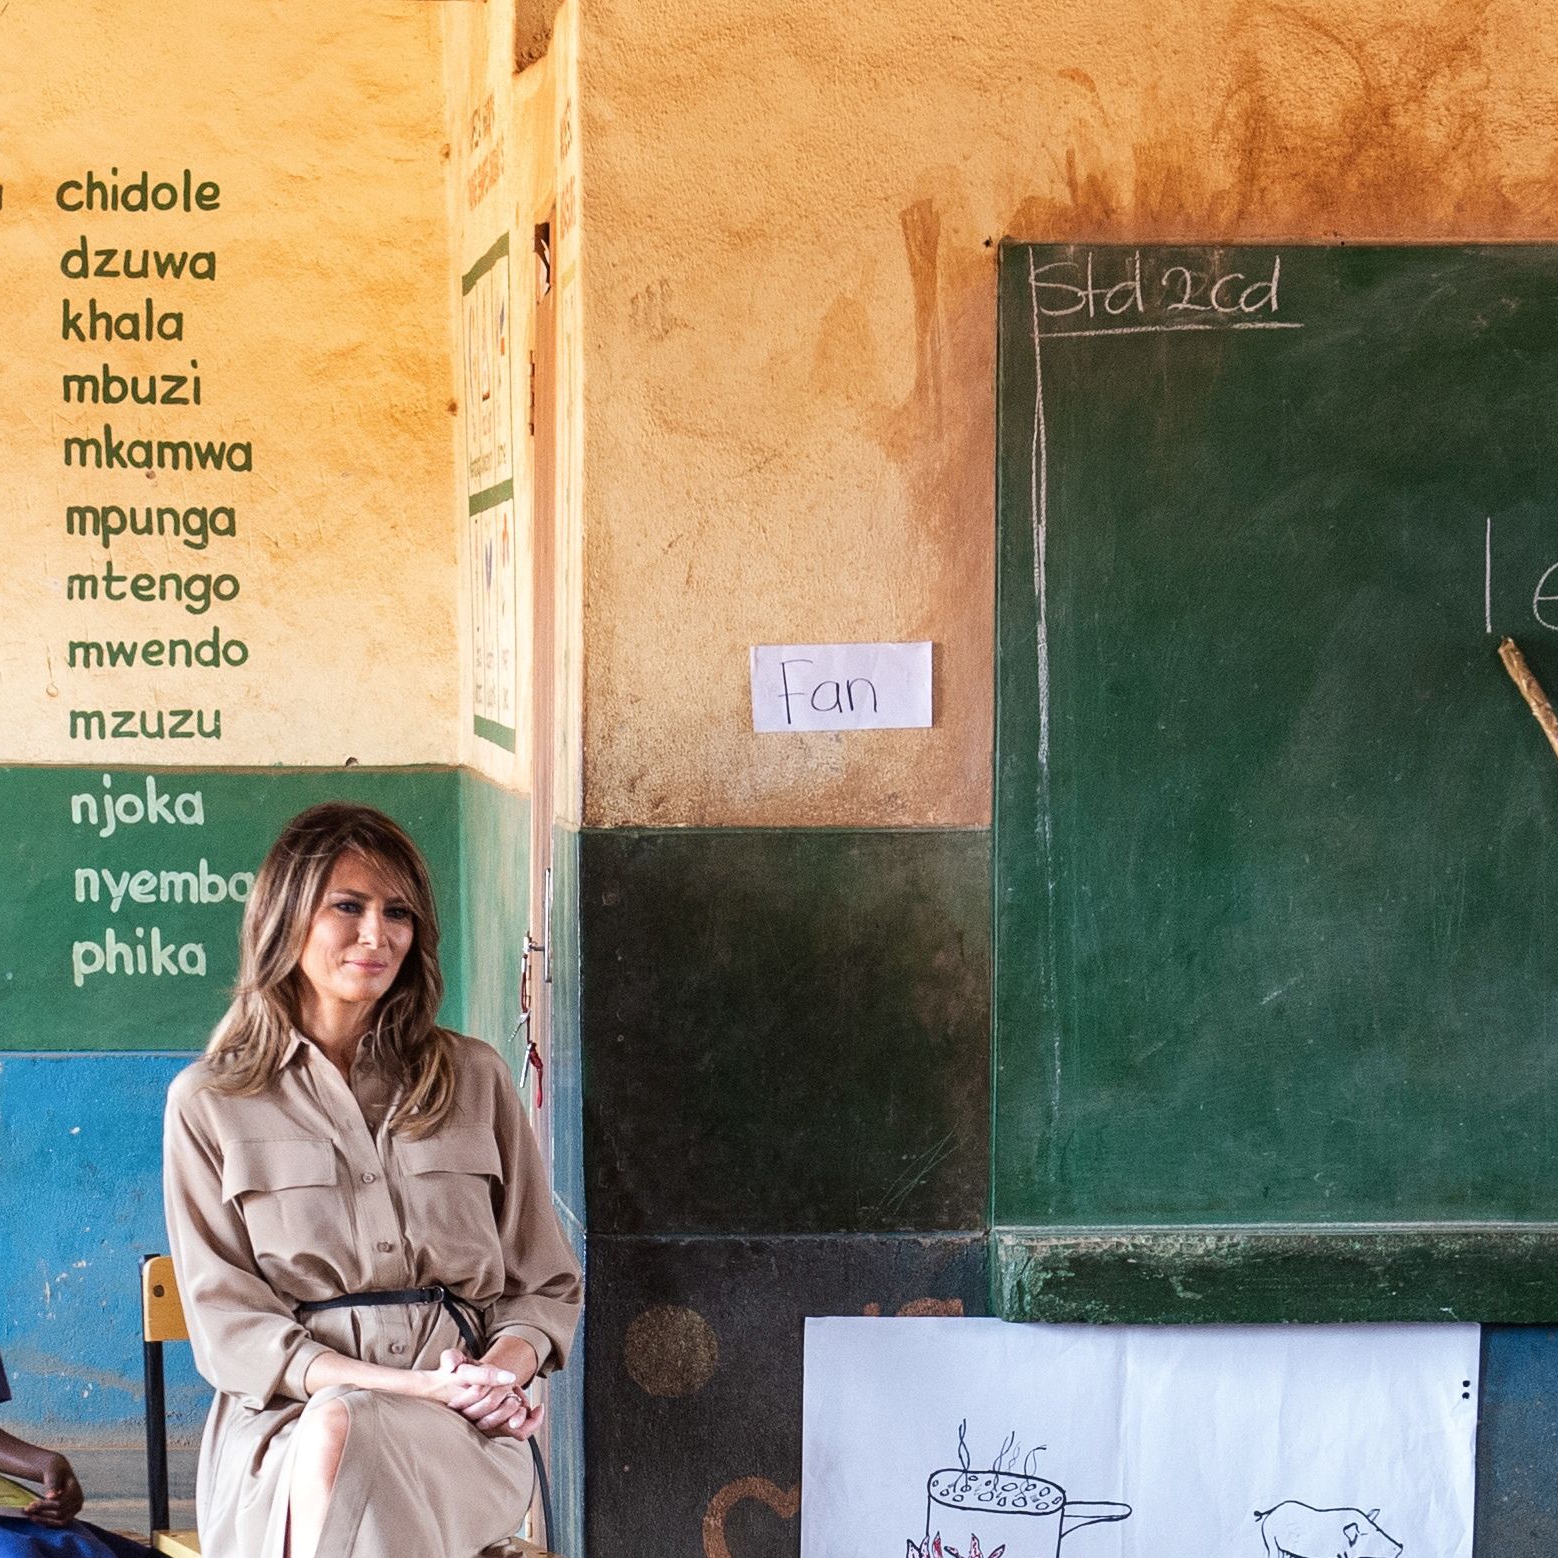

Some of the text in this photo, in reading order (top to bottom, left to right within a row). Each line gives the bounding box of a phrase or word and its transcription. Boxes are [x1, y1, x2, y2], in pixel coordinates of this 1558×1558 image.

[56, 167, 220, 212] chidole
[61, 236, 215, 281] dzuwa
[1033, 249, 1145, 317] Std
[62, 298, 183, 342] khala
[63, 360, 200, 405] mbuzi
[65, 424, 252, 472] mkamwa
[67, 506, 236, 550] mpunga
[67, 561, 240, 614] mtengo
[68, 626, 248, 668] mwendo
[777, 658, 879, 726] Fan
[70, 710, 221, 740] mzuzu
[72, 774, 204, 837] njoka
[74, 858, 253, 912] nyemba
[73, 927, 206, 987] phika
